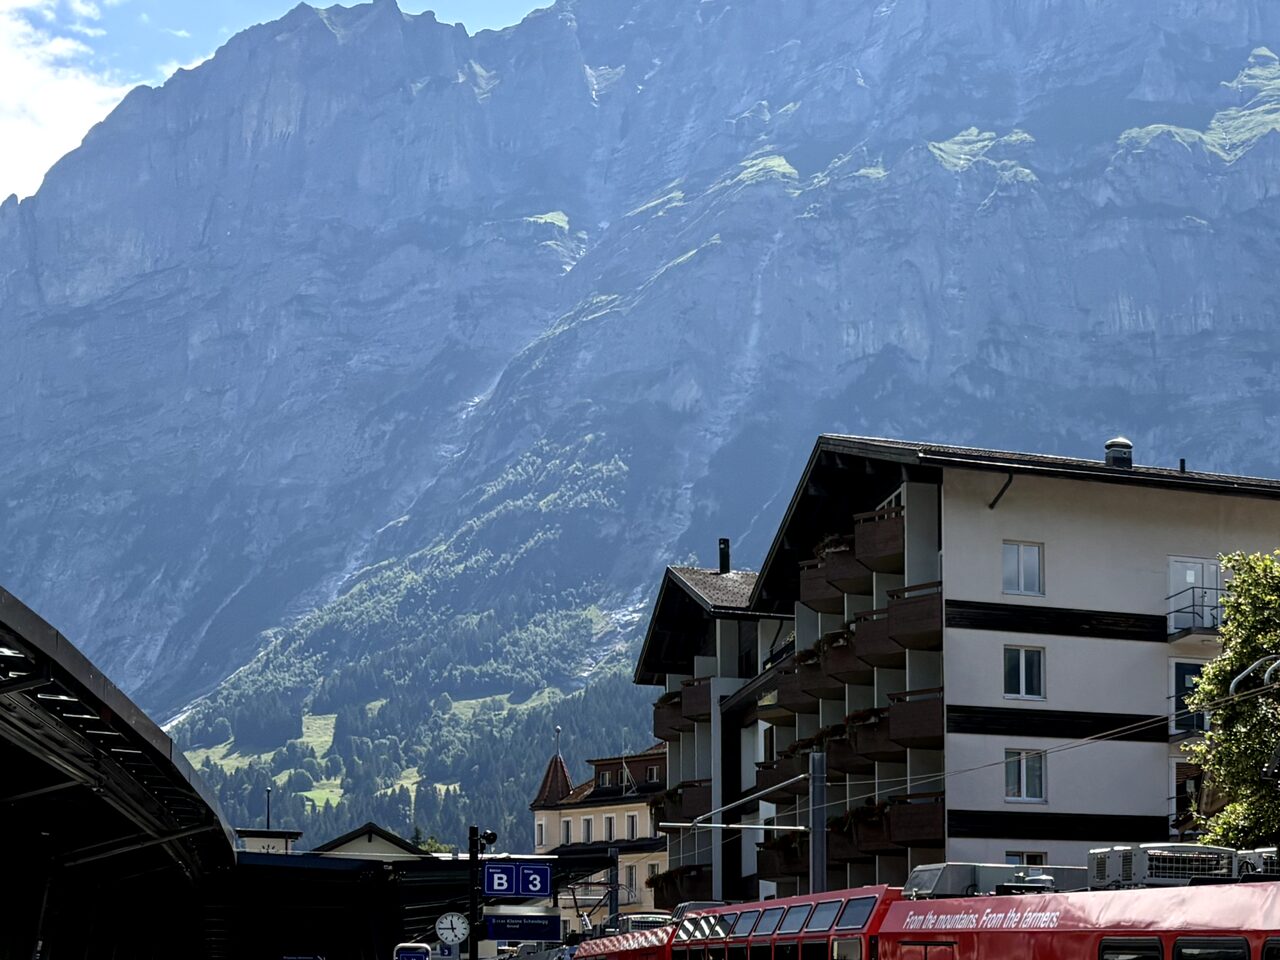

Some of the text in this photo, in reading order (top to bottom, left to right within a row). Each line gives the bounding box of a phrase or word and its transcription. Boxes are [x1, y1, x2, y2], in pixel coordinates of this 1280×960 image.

[493, 873, 508, 890] B
[528, 874, 541, 891] 3
[903, 911, 924, 929] From
[922, 911, 937, 929] the
[978, 908, 1005, 929] From
[1002, 908, 1021, 929] the
